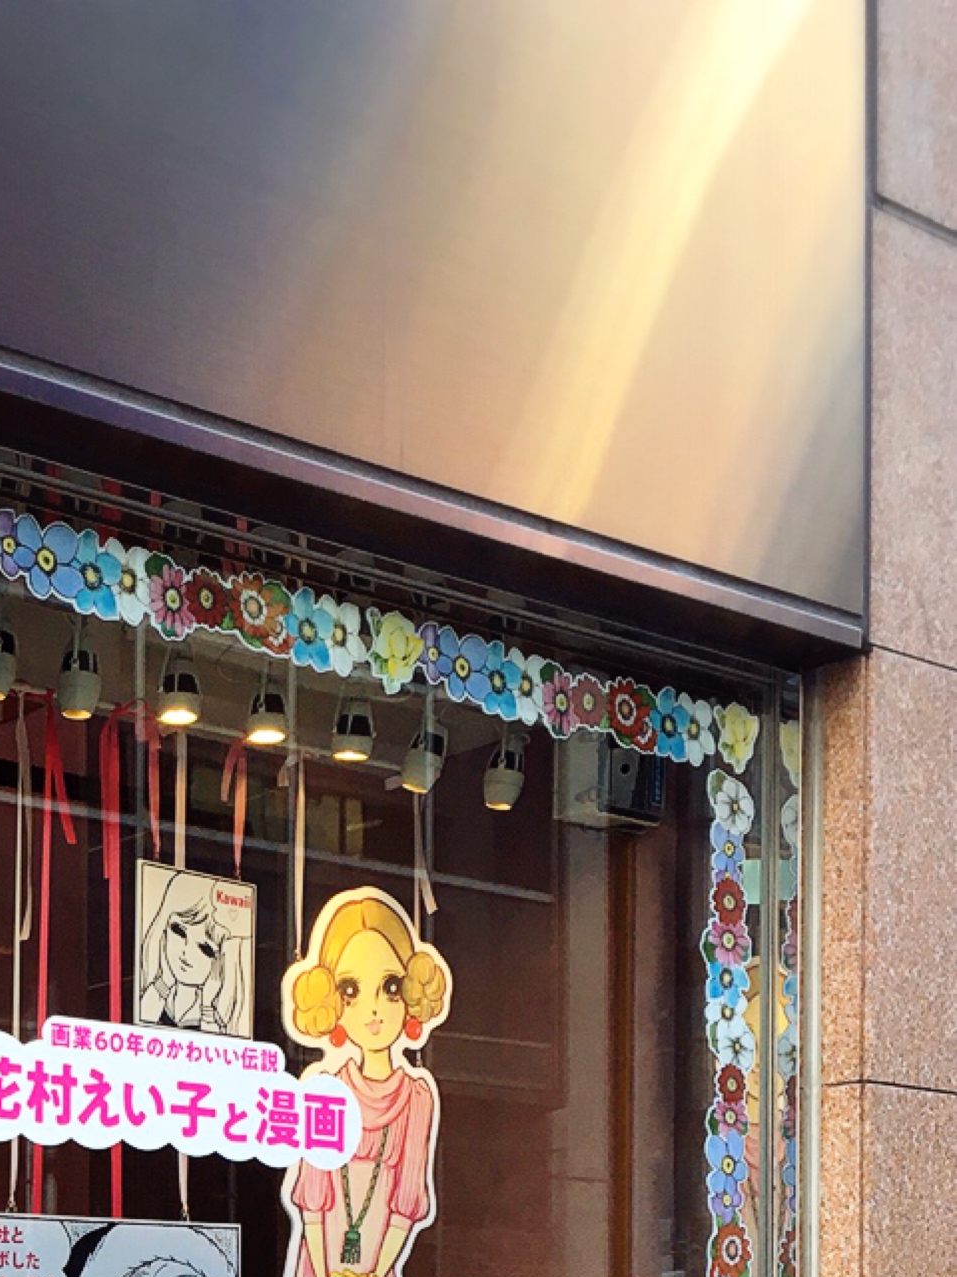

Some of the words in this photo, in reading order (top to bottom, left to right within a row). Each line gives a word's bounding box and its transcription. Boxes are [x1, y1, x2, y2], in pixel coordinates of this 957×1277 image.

[216, 889, 252, 909] Kawaii
[50, 1022, 278, 1073] 画業60年のかわいい伝説
